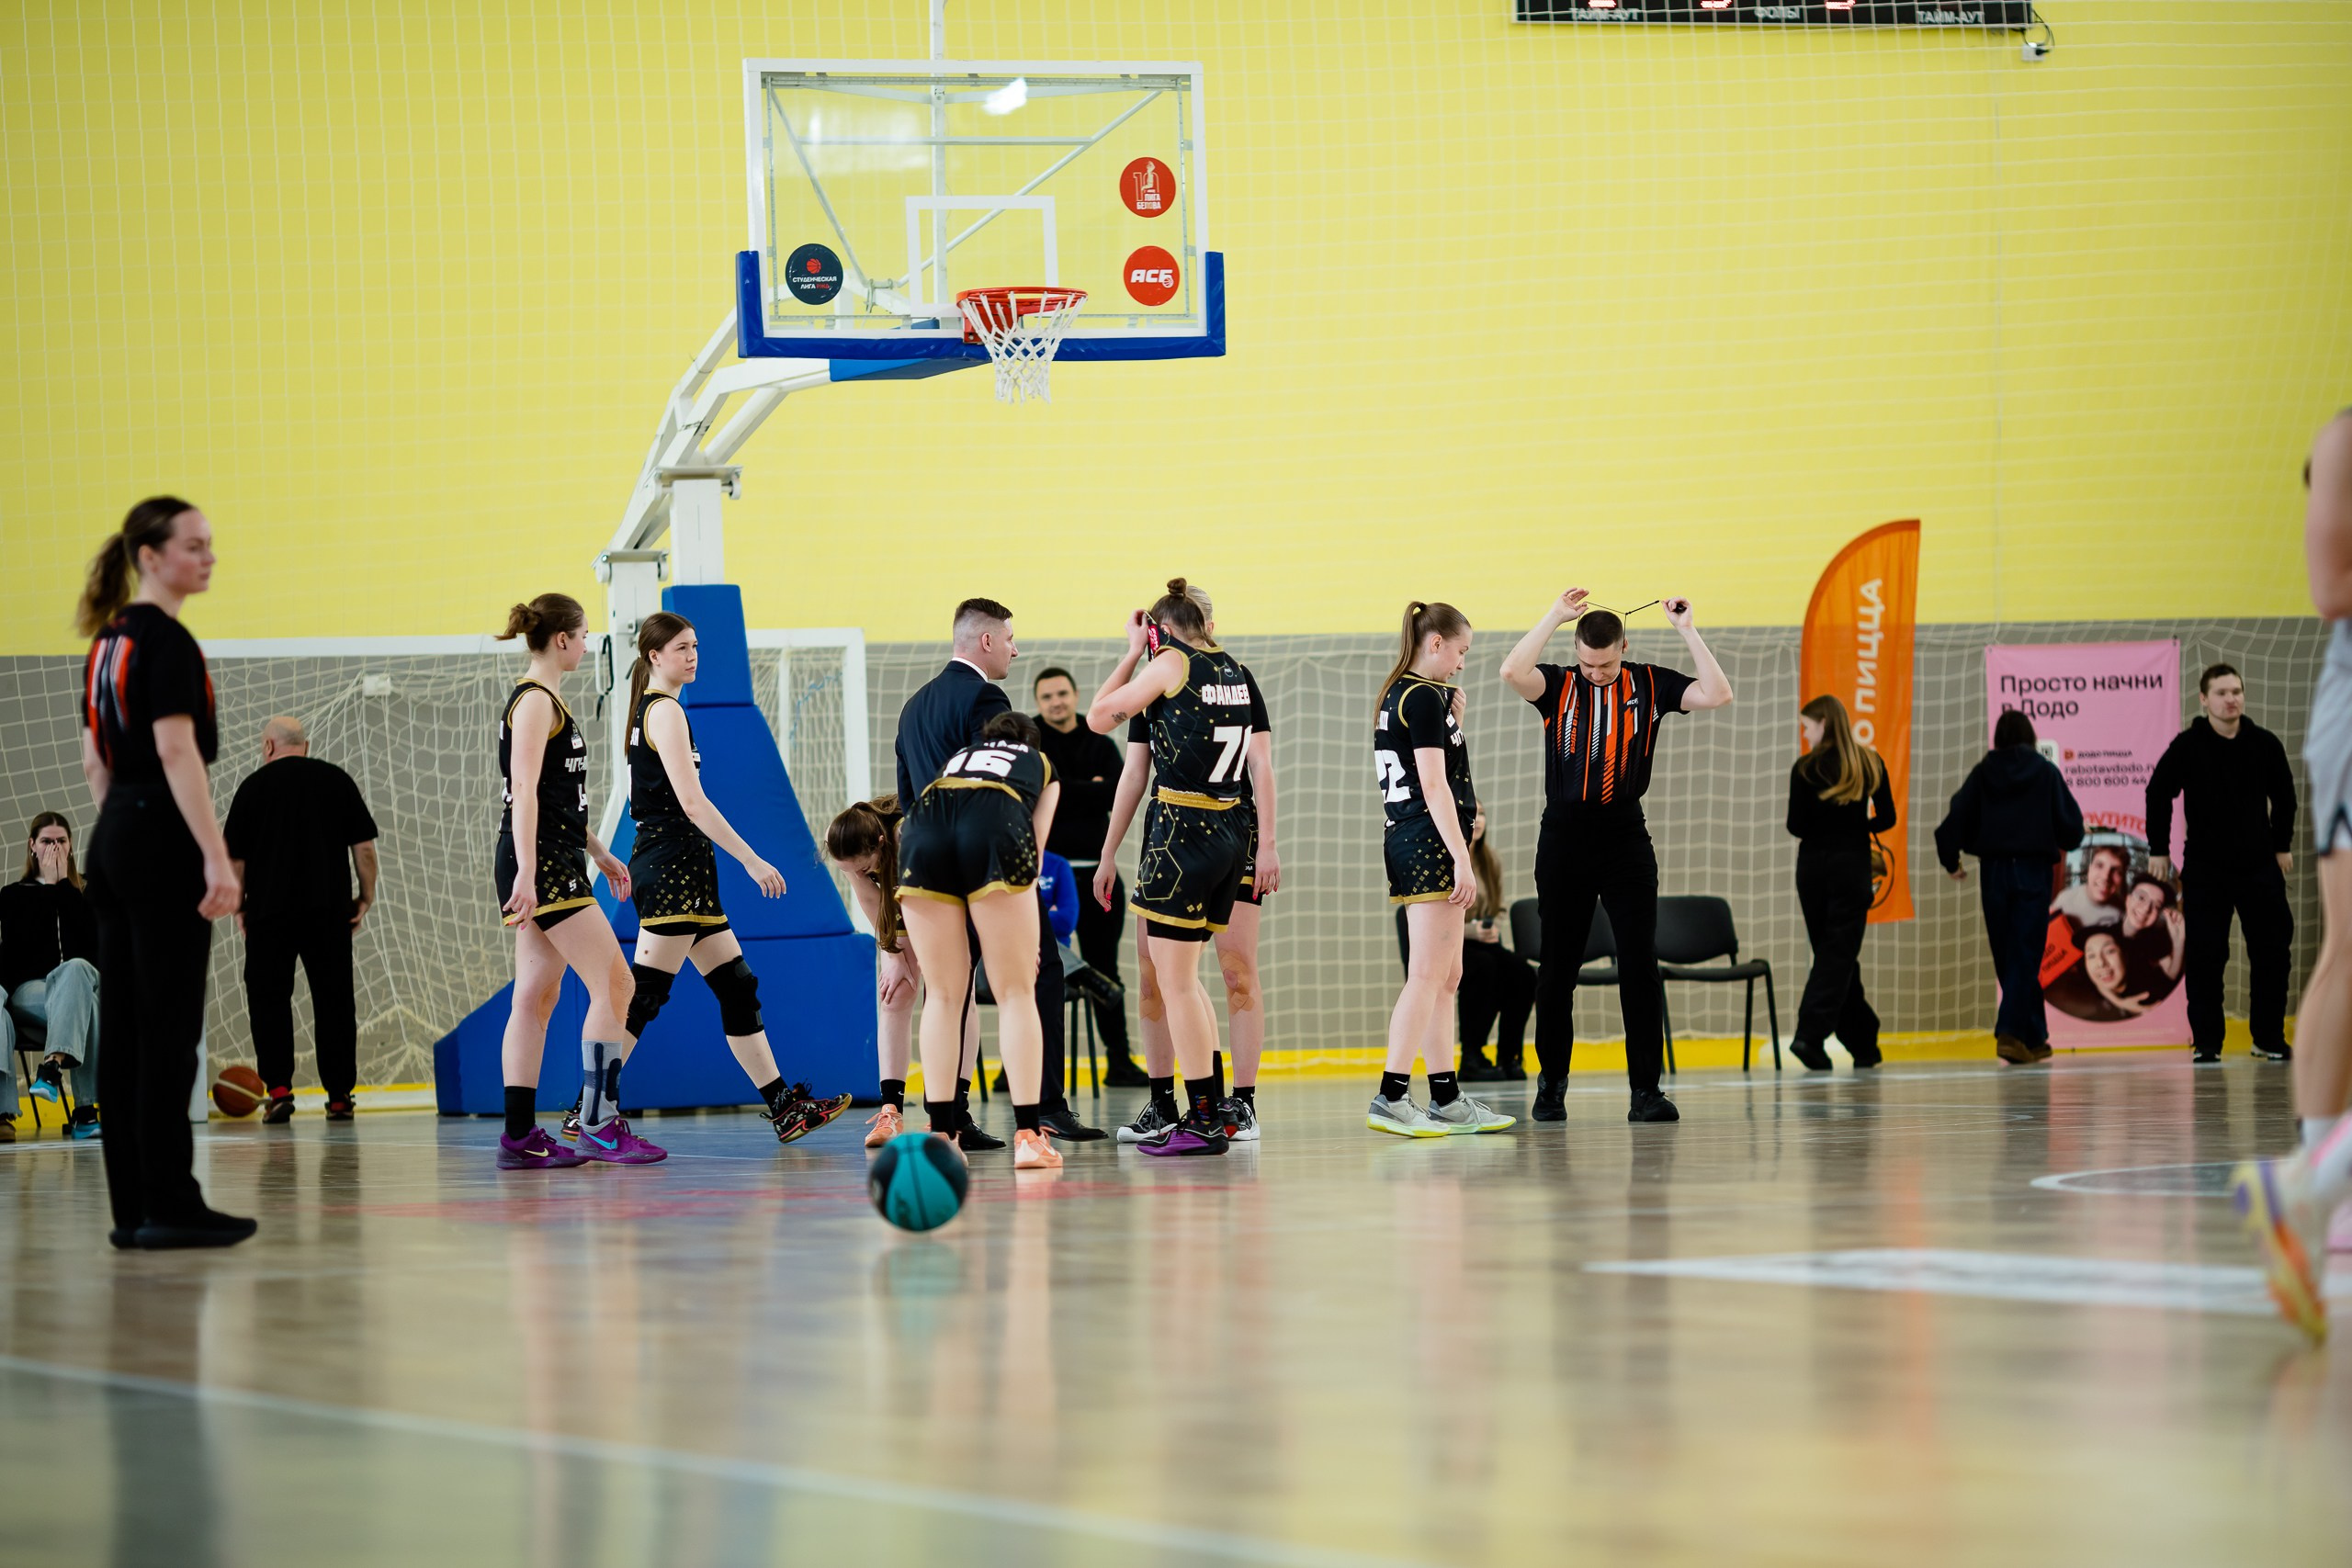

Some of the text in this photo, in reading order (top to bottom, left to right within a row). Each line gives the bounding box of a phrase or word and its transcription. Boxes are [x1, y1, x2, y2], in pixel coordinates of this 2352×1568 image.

[1569, 7, 1639, 20] ТАЙМ-АУТ
[1754, 6, 1800, 18] ФОЛЫ
[1917, 9, 1984, 23] ТАЙМ-АУТ
[1144, 193, 1161, 201] ЛИГА
[1136, 201, 1161, 209] БЕЛОВА
[1130, 269, 1173, 284] АСБ
[1855, 578, 1885, 713] ПИЦЦА
[2000, 673, 2164, 696] Просто начни
[2021, 699, 2079, 719] Додо
